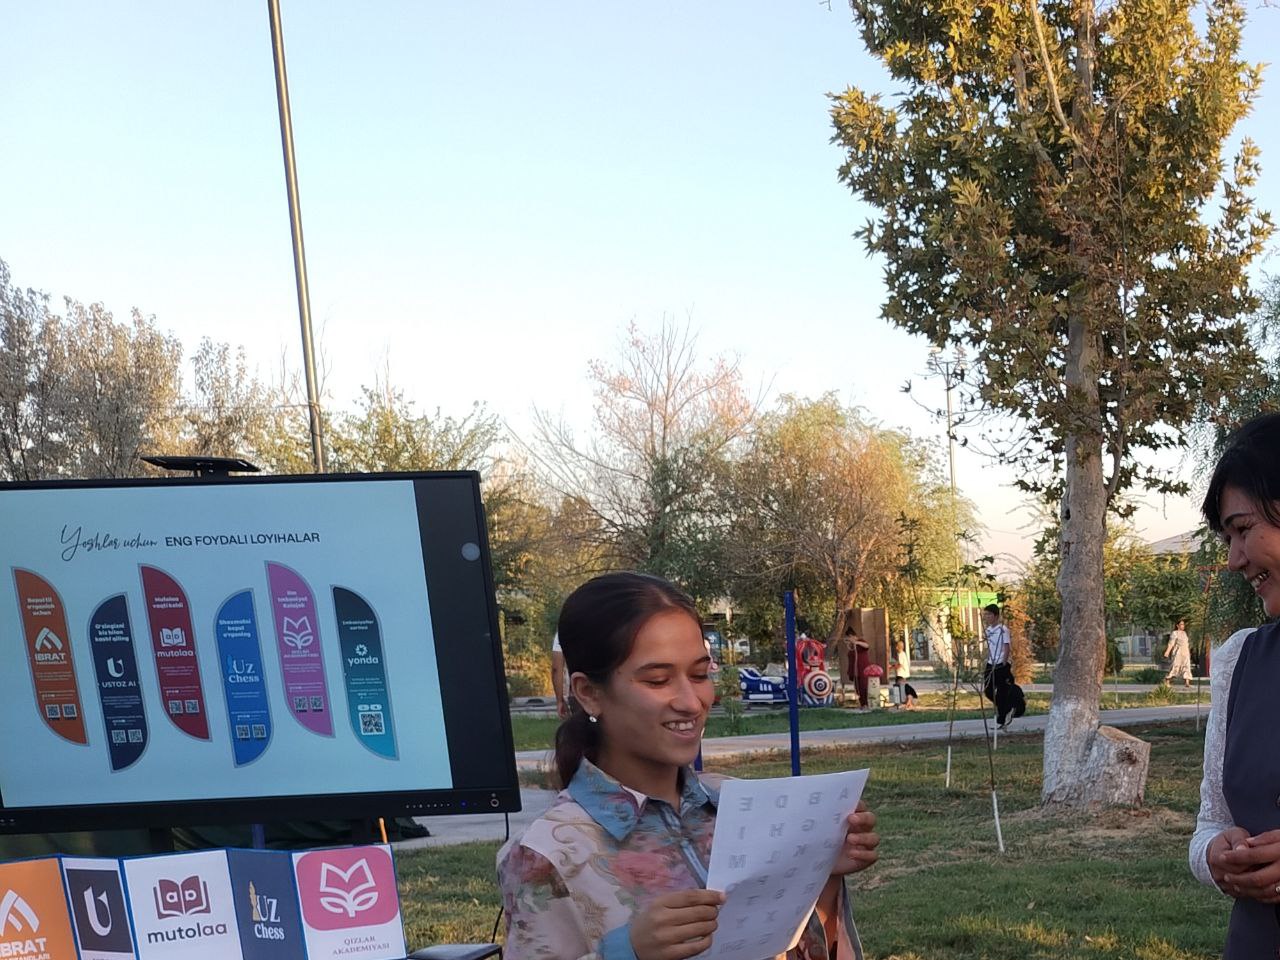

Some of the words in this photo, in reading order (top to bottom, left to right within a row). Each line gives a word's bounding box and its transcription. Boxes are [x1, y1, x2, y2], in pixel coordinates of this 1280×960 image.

[60, 524, 120, 561] Yoshlar
[165, 536, 193, 547] ENG
[195, 534, 248, 546] FOYDALI
[250, 532, 321, 545] LOYIHALAR
[35, 653, 66, 661] IBRAT
[157, 649, 194, 657] mutolaa
[348, 656, 379, 667] yonda
[228, 674, 260, 684] Chess
[147, 922, 228, 944] mutolaa
[254, 922, 285, 940] Chess
[343, 936, 375, 946] QIZLAR
[0, 937, 47, 957] BRAT
[333, 943, 390, 955] AKADEMIYASI
